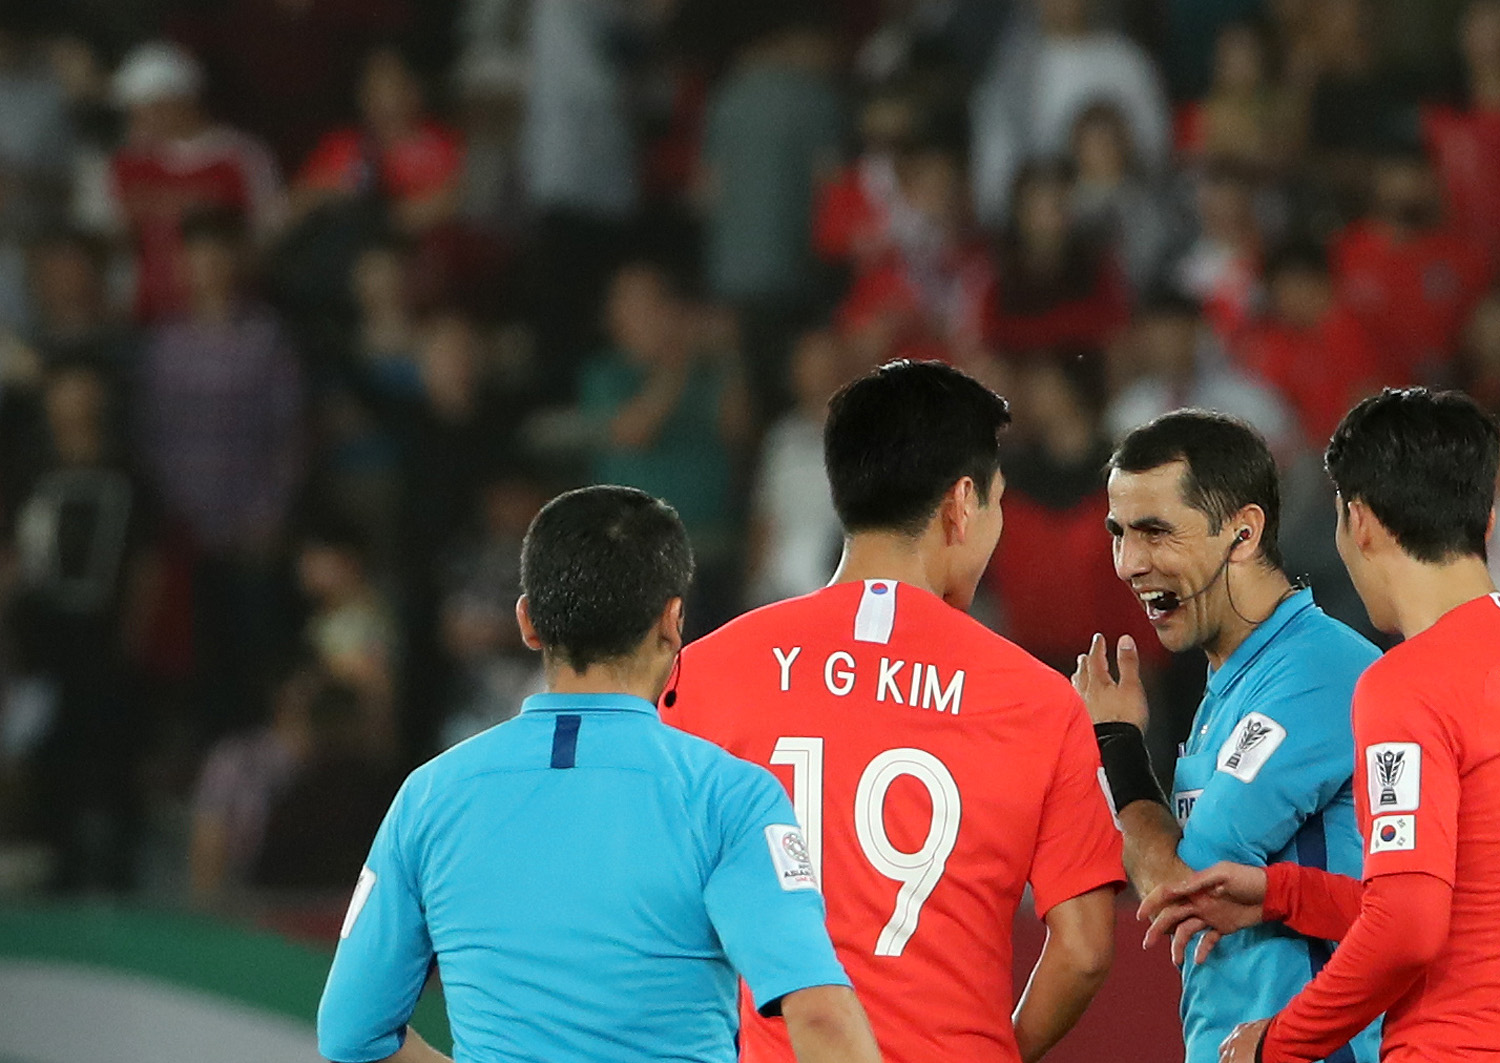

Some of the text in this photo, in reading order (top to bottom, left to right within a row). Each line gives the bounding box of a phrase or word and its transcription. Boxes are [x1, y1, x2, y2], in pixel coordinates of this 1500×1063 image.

[772, 646, 966, 716] Y G KIM
[769, 736, 963, 957] 19
